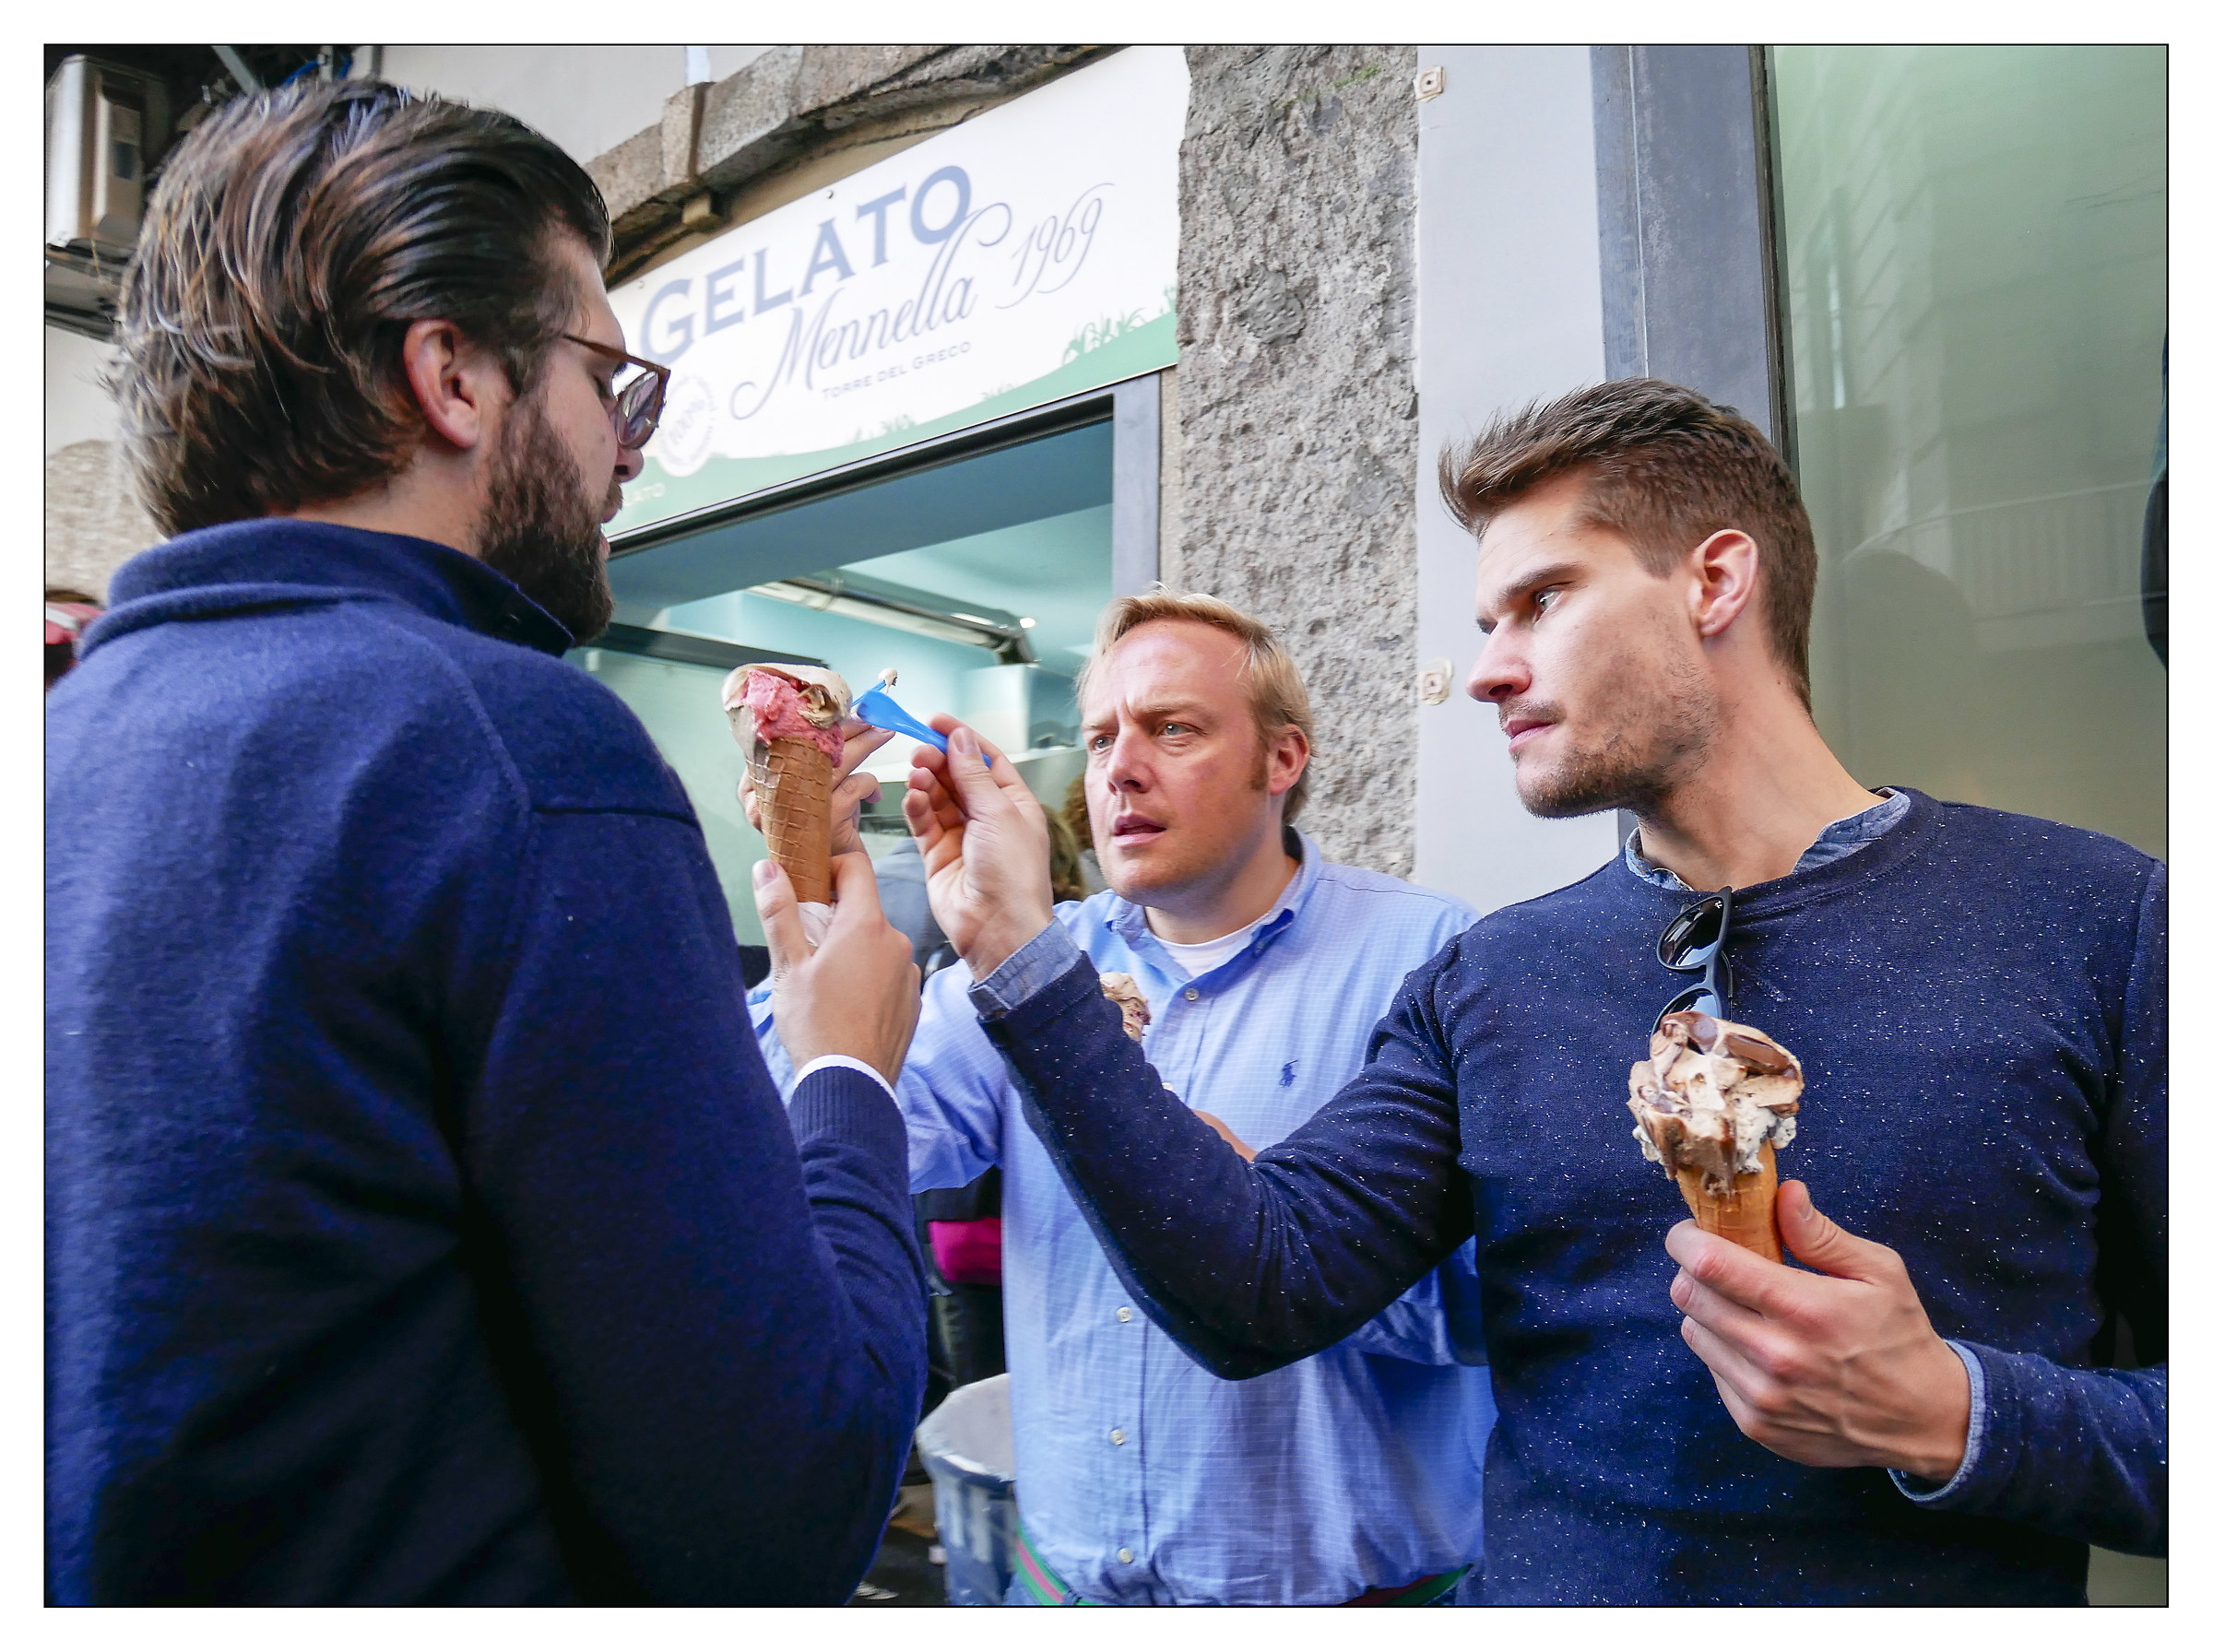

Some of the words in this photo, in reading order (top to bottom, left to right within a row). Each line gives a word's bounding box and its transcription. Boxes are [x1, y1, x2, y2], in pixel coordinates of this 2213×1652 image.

[640, 164, 972, 364] GELATO
[729, 202, 1012, 420] Mennella
[996, 183, 1116, 310] 1969
[822, 374, 873, 400] TORRE
[877, 365, 907, 383] DEL
[912, 341, 971, 370] GRECO
